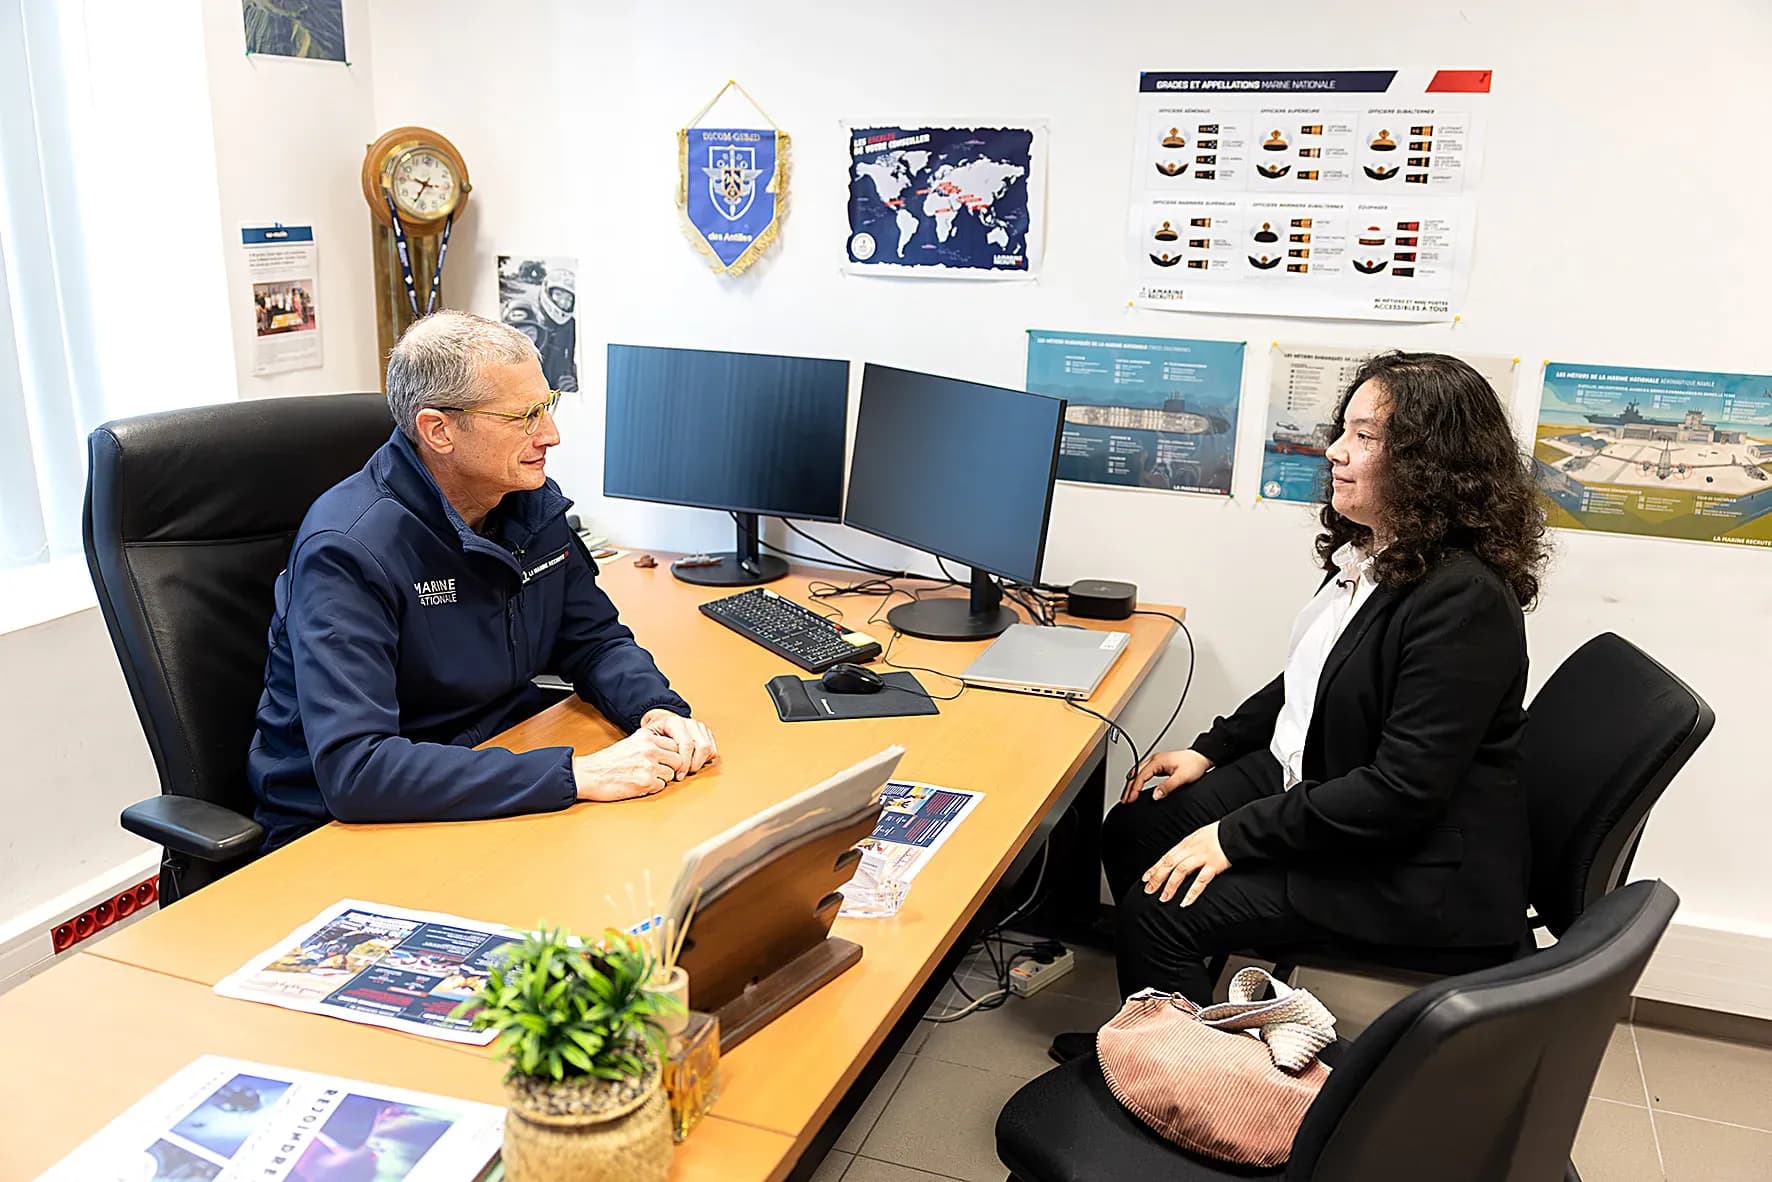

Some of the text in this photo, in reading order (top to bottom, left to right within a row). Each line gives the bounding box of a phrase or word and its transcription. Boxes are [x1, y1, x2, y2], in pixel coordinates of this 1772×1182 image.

[1156, 80, 1336, 89] GRADES ET APPELLATIONS MARINE NATIONALE
[1629, 375, 1660, 384] NATIONALE
[414, 578, 456, 594] MARINE
[420, 592, 458, 606] ATIONALE
[264, 1088, 338, 1175] REJOINDRE
